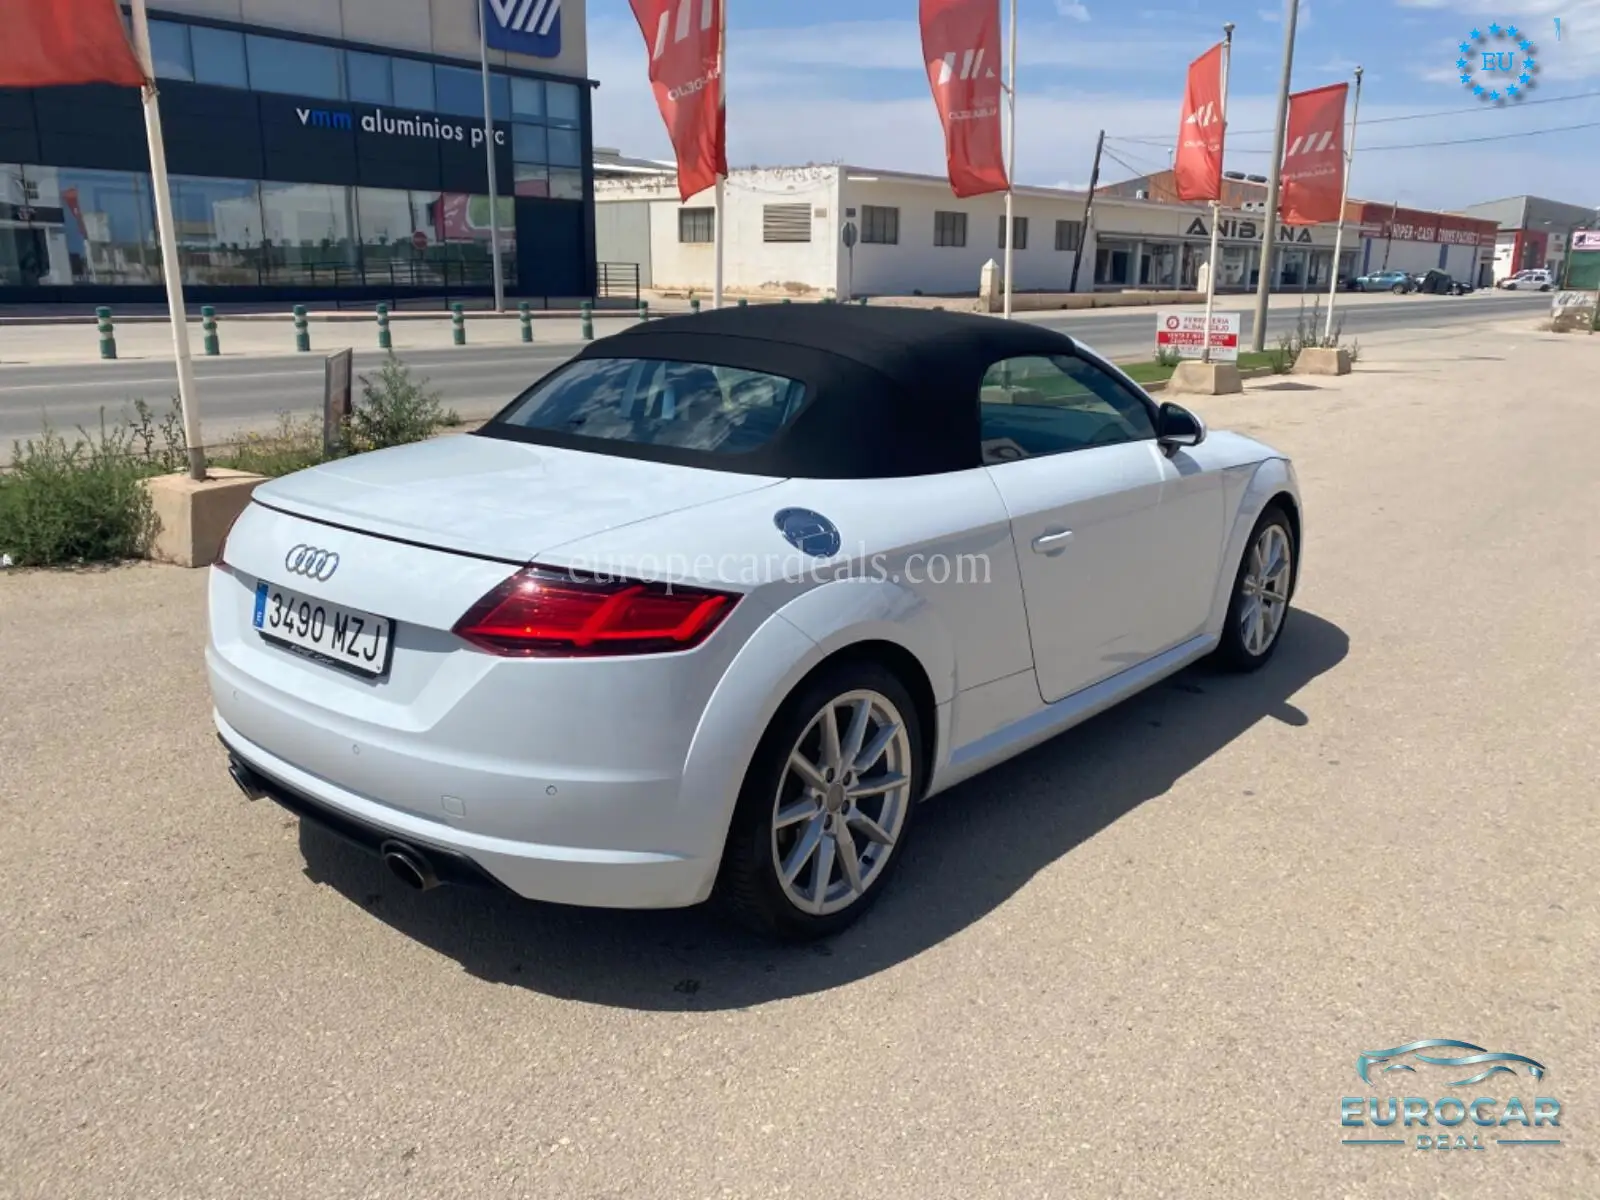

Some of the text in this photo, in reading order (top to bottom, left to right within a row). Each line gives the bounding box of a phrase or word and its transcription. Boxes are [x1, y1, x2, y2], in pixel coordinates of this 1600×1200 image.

[296, 107, 351, 130] vmm
[361, 108, 464, 142] aluminios
[1186, 216, 1313, 243] ANIBNA
[269, 592, 327, 643] 3490
[331, 611, 381, 662] MZJ
